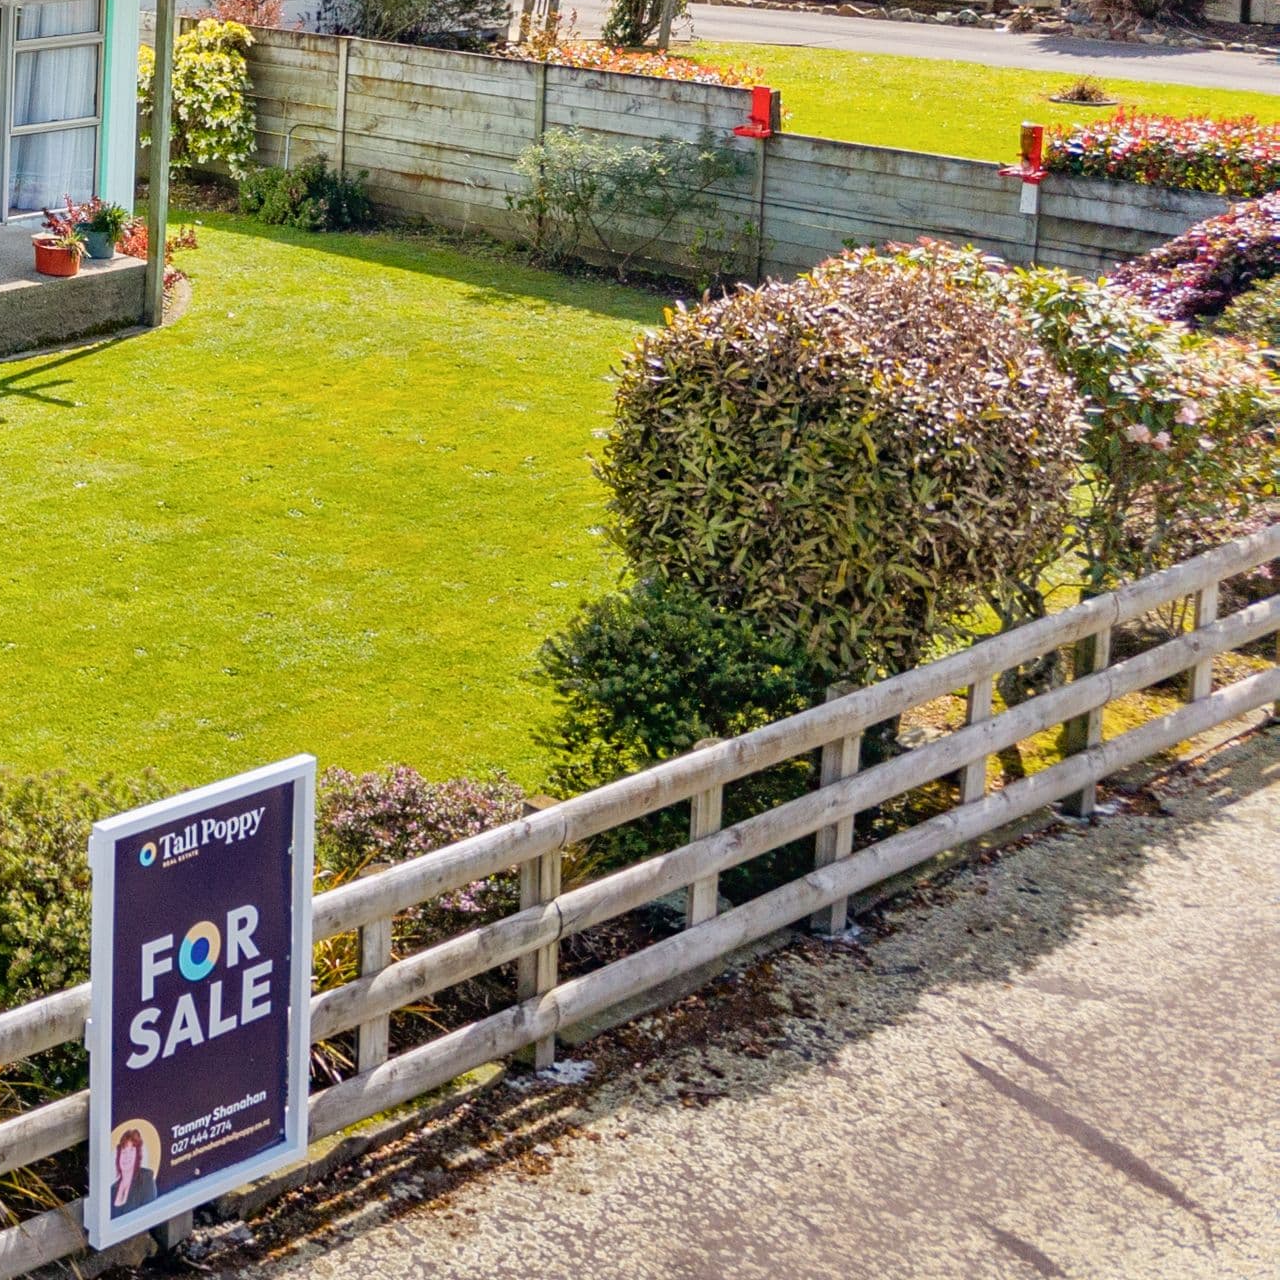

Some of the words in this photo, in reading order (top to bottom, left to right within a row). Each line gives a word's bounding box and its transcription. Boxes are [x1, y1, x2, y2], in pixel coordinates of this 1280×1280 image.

[159, 823, 199, 859] Tall
[201, 807, 266, 845] Poppy
[162, 858, 177, 868] REAL
[177, 849, 199, 863] ESTATE
[142, 904, 260, 1001] FOR
[126, 960, 273, 1069] SALE
[171, 1114, 212, 1139] Tammy
[212, 1090, 267, 1121] Shanahan
[171, 1138, 189, 1155] 027
[190, 1130, 208, 1146] 444
[209, 1120, 233, 1138] 2774
